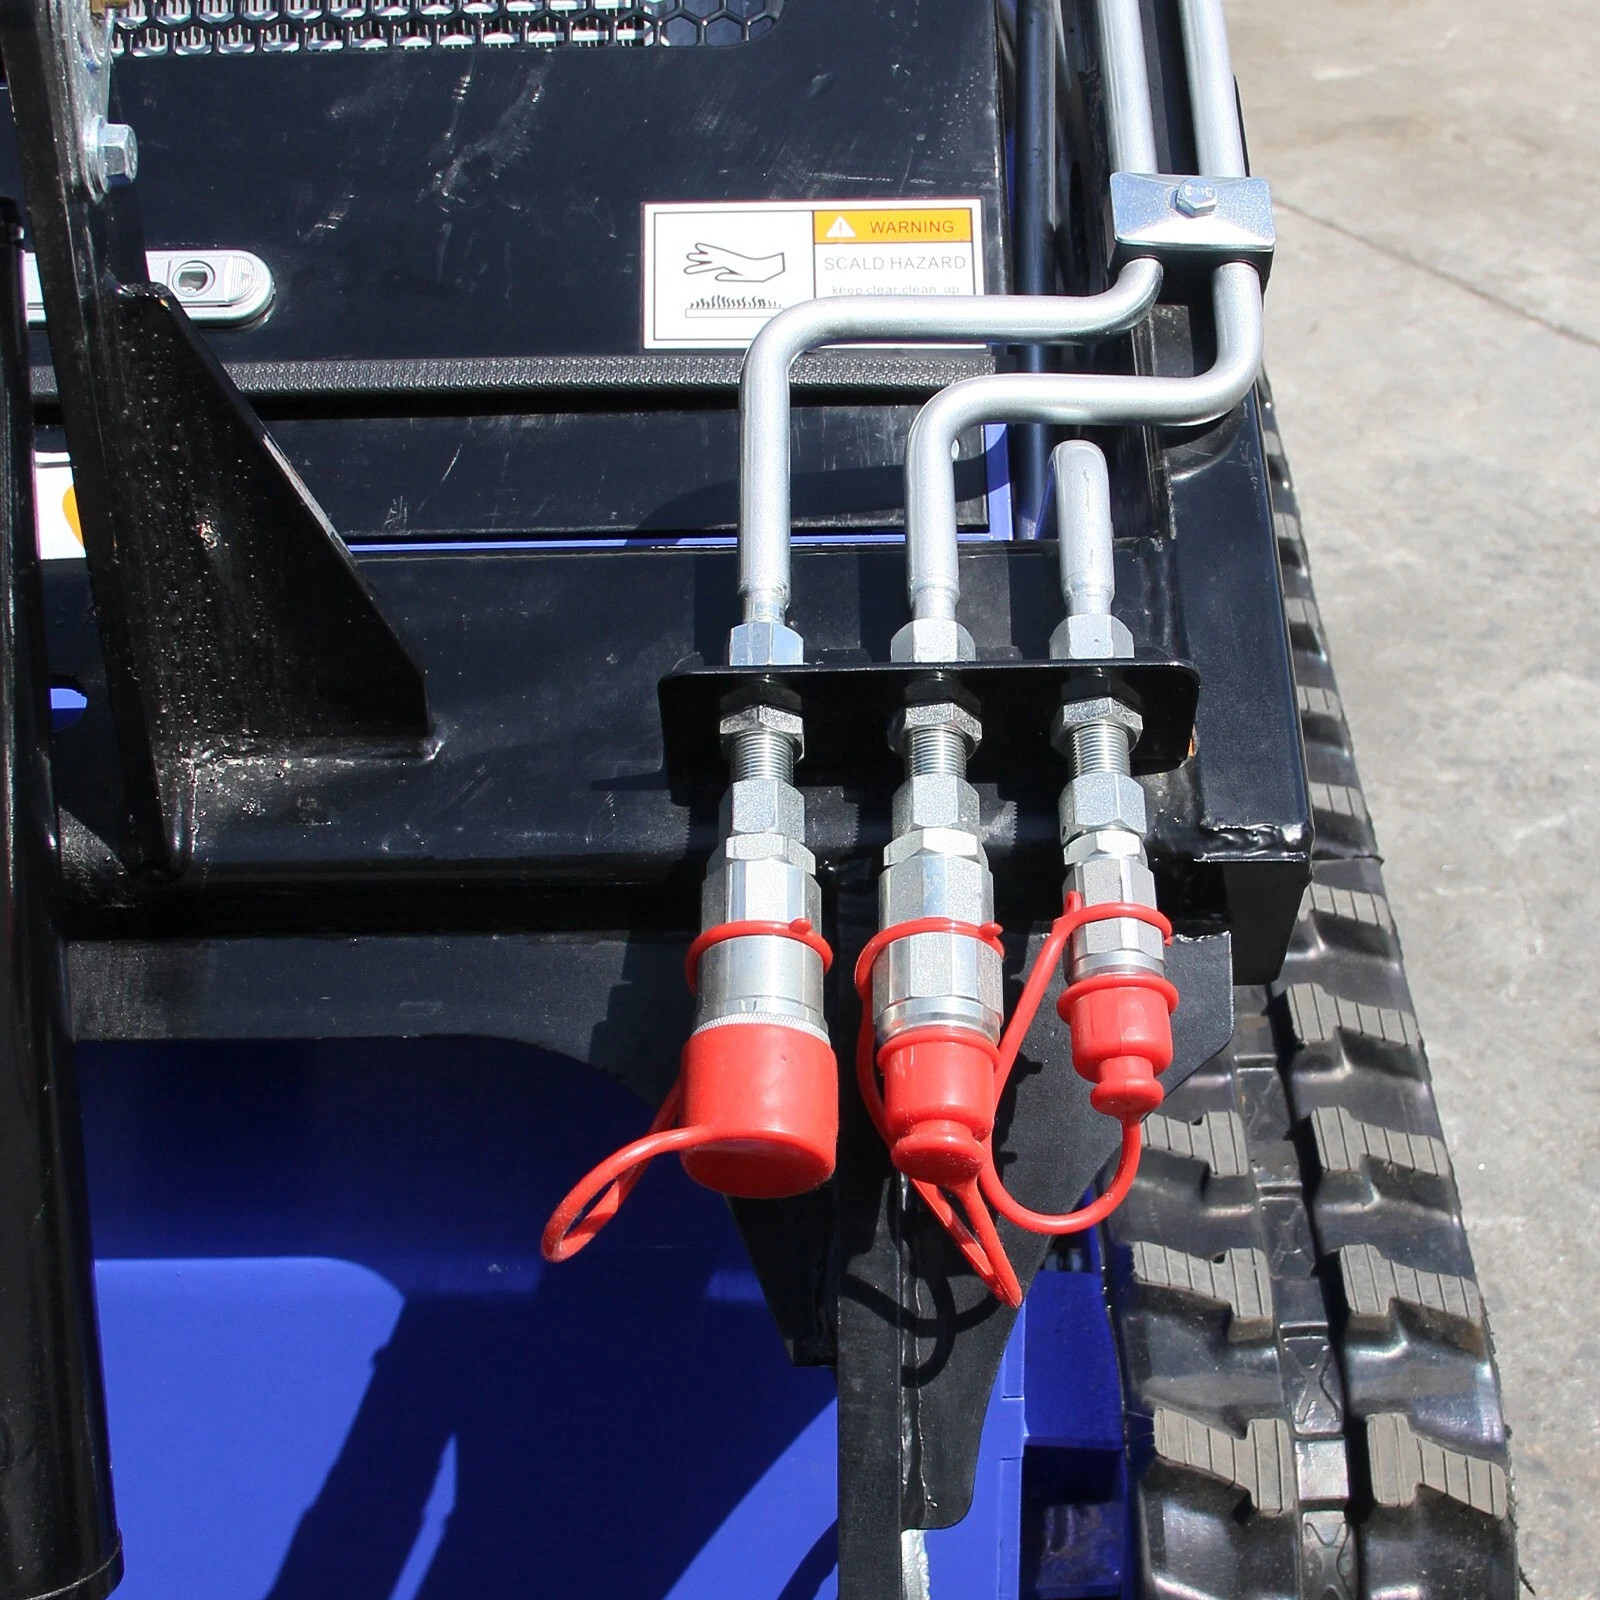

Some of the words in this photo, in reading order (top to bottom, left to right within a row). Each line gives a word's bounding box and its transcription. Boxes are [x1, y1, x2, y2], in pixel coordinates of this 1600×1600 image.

[870, 220, 954, 234] WARNING
[824, 257, 885, 270] SCALD
[890, 256, 966, 270] HAZARD
[832, 285, 862, 295] keep
[943, 286, 960, 296] up
